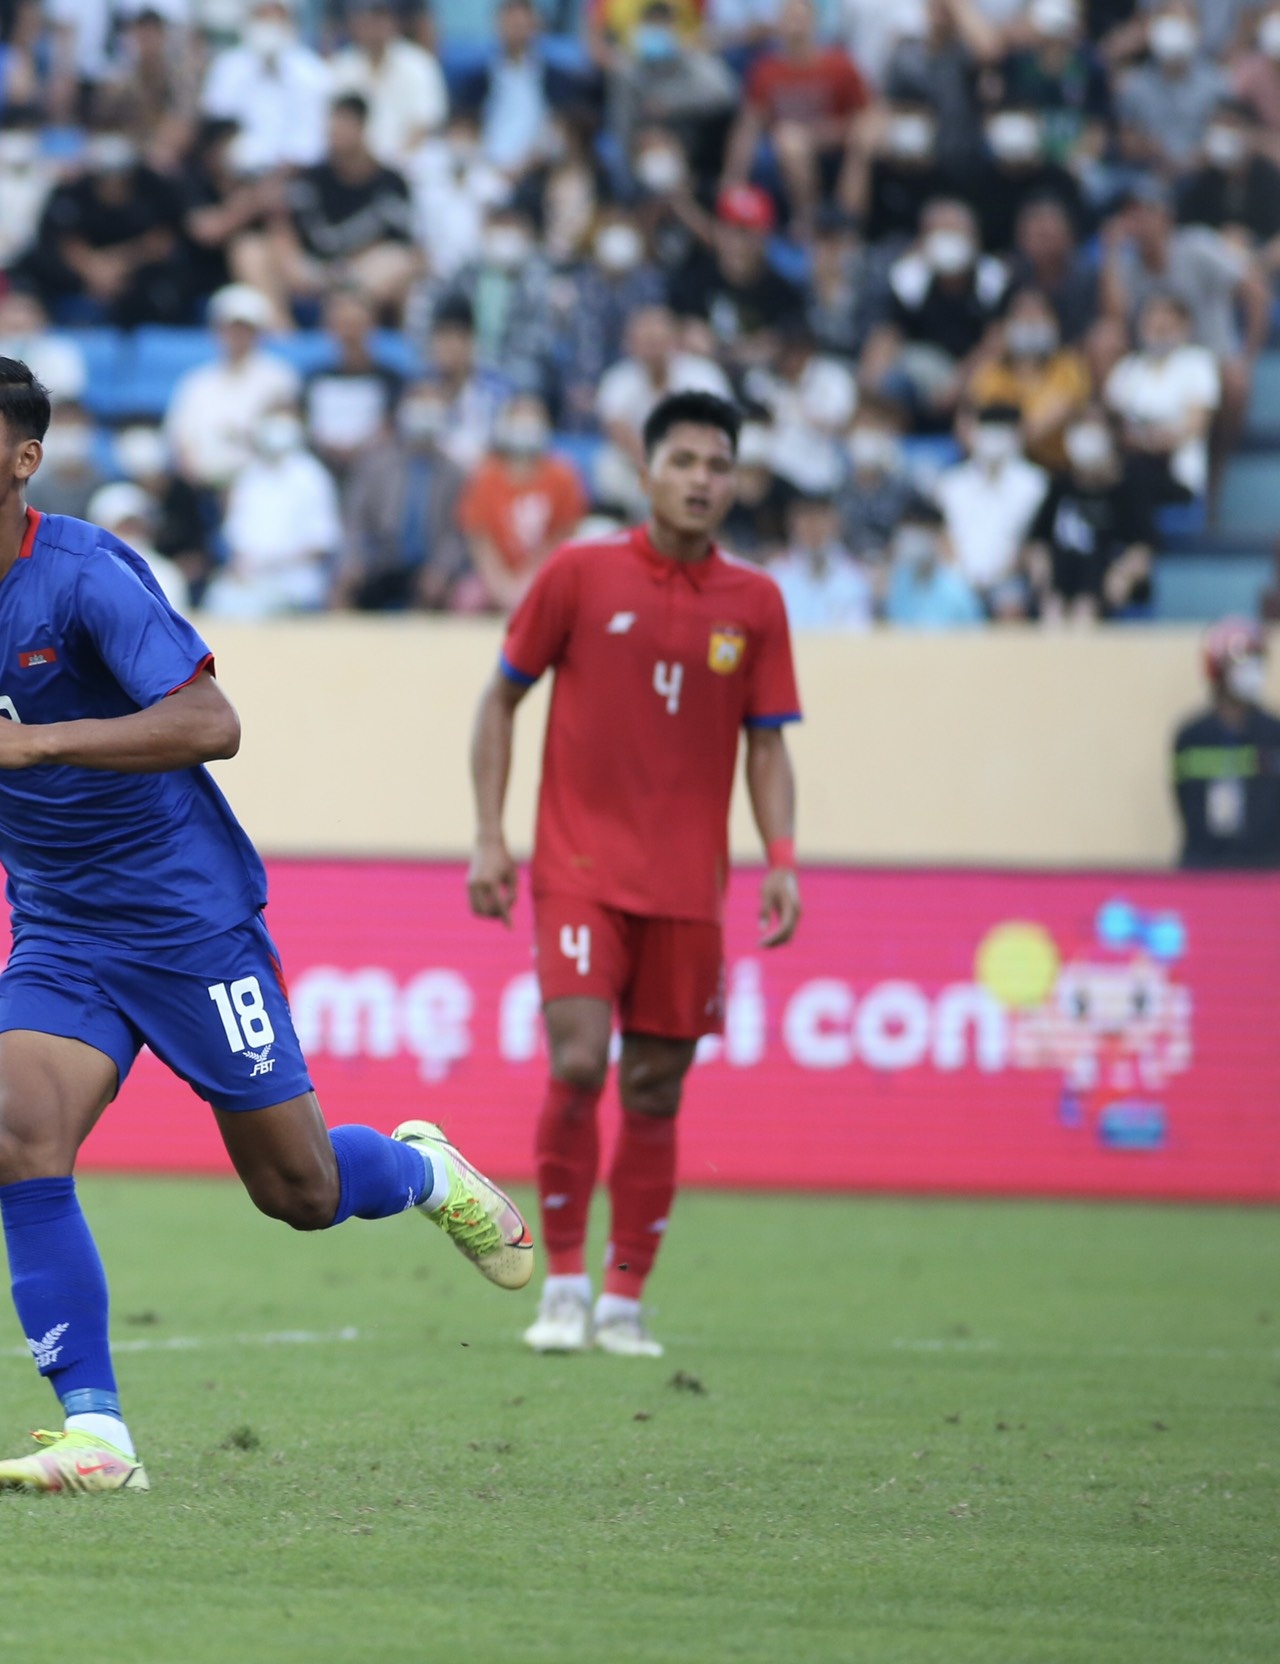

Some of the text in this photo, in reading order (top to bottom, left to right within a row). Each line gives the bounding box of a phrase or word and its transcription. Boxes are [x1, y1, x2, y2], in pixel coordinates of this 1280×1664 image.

[653, 660, 683, 715] 4
[561, 924, 590, 976] 4
[208, 976, 275, 1053] 18
[291, 967, 471, 1083] mẹ
[785, 977, 1007, 1073] con
[249, 1058, 276, 1077] FBT
